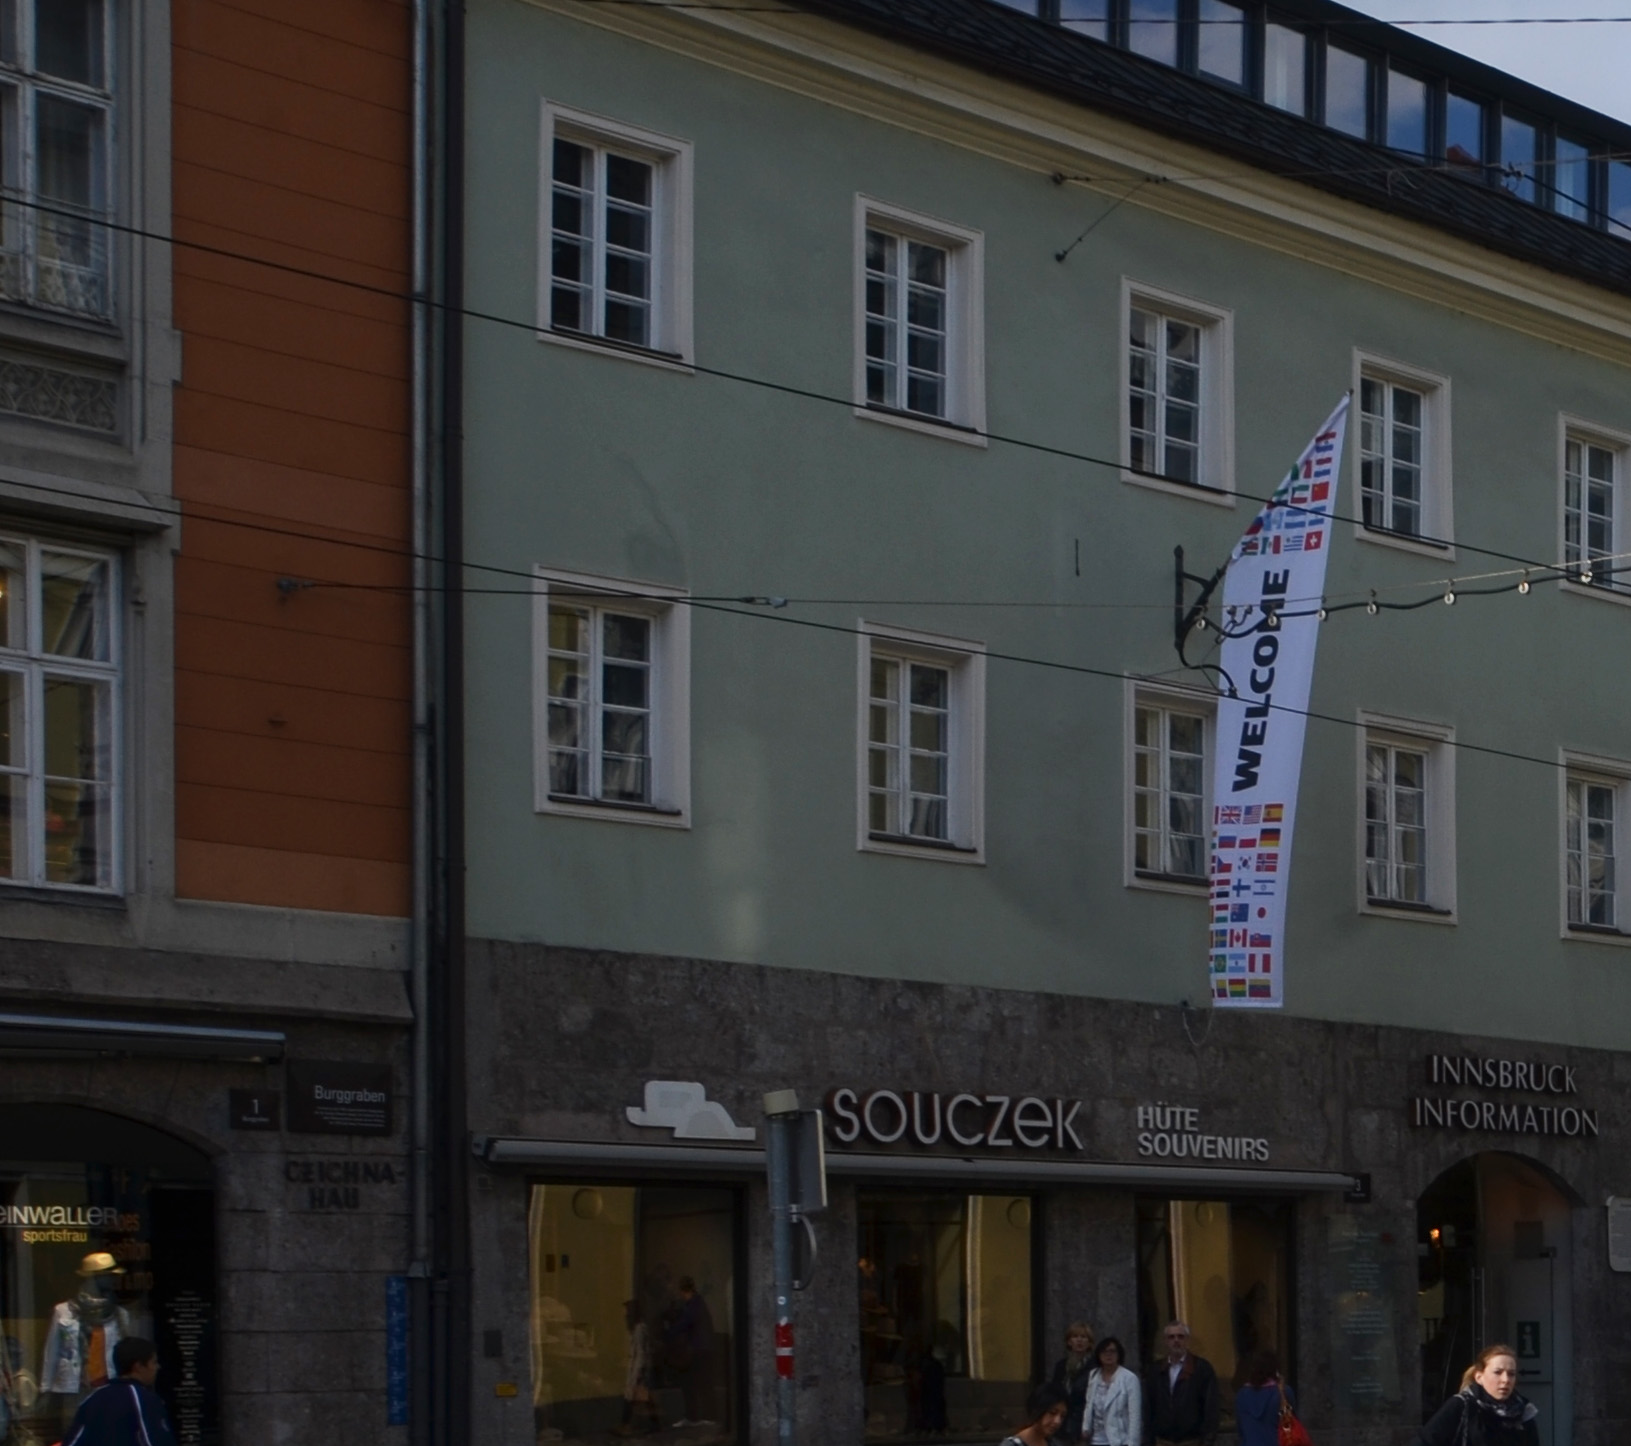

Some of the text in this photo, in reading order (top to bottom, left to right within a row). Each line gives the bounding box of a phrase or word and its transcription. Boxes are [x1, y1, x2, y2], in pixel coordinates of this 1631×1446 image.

[1231, 568, 1291, 793] WELCOME
[1432, 1055, 1579, 1094] INNSBRUCK
[252, 1098, 260, 1115] 1
[314, 1084, 387, 1105] Burggraben
[1137, 1100, 1200, 1132] HÜTE
[1414, 1097, 1599, 1136] INFORMATION
[1137, 1131, 1270, 1162] SOUVENIRS
[22, 1228, 88, 1244] sportsfrau
